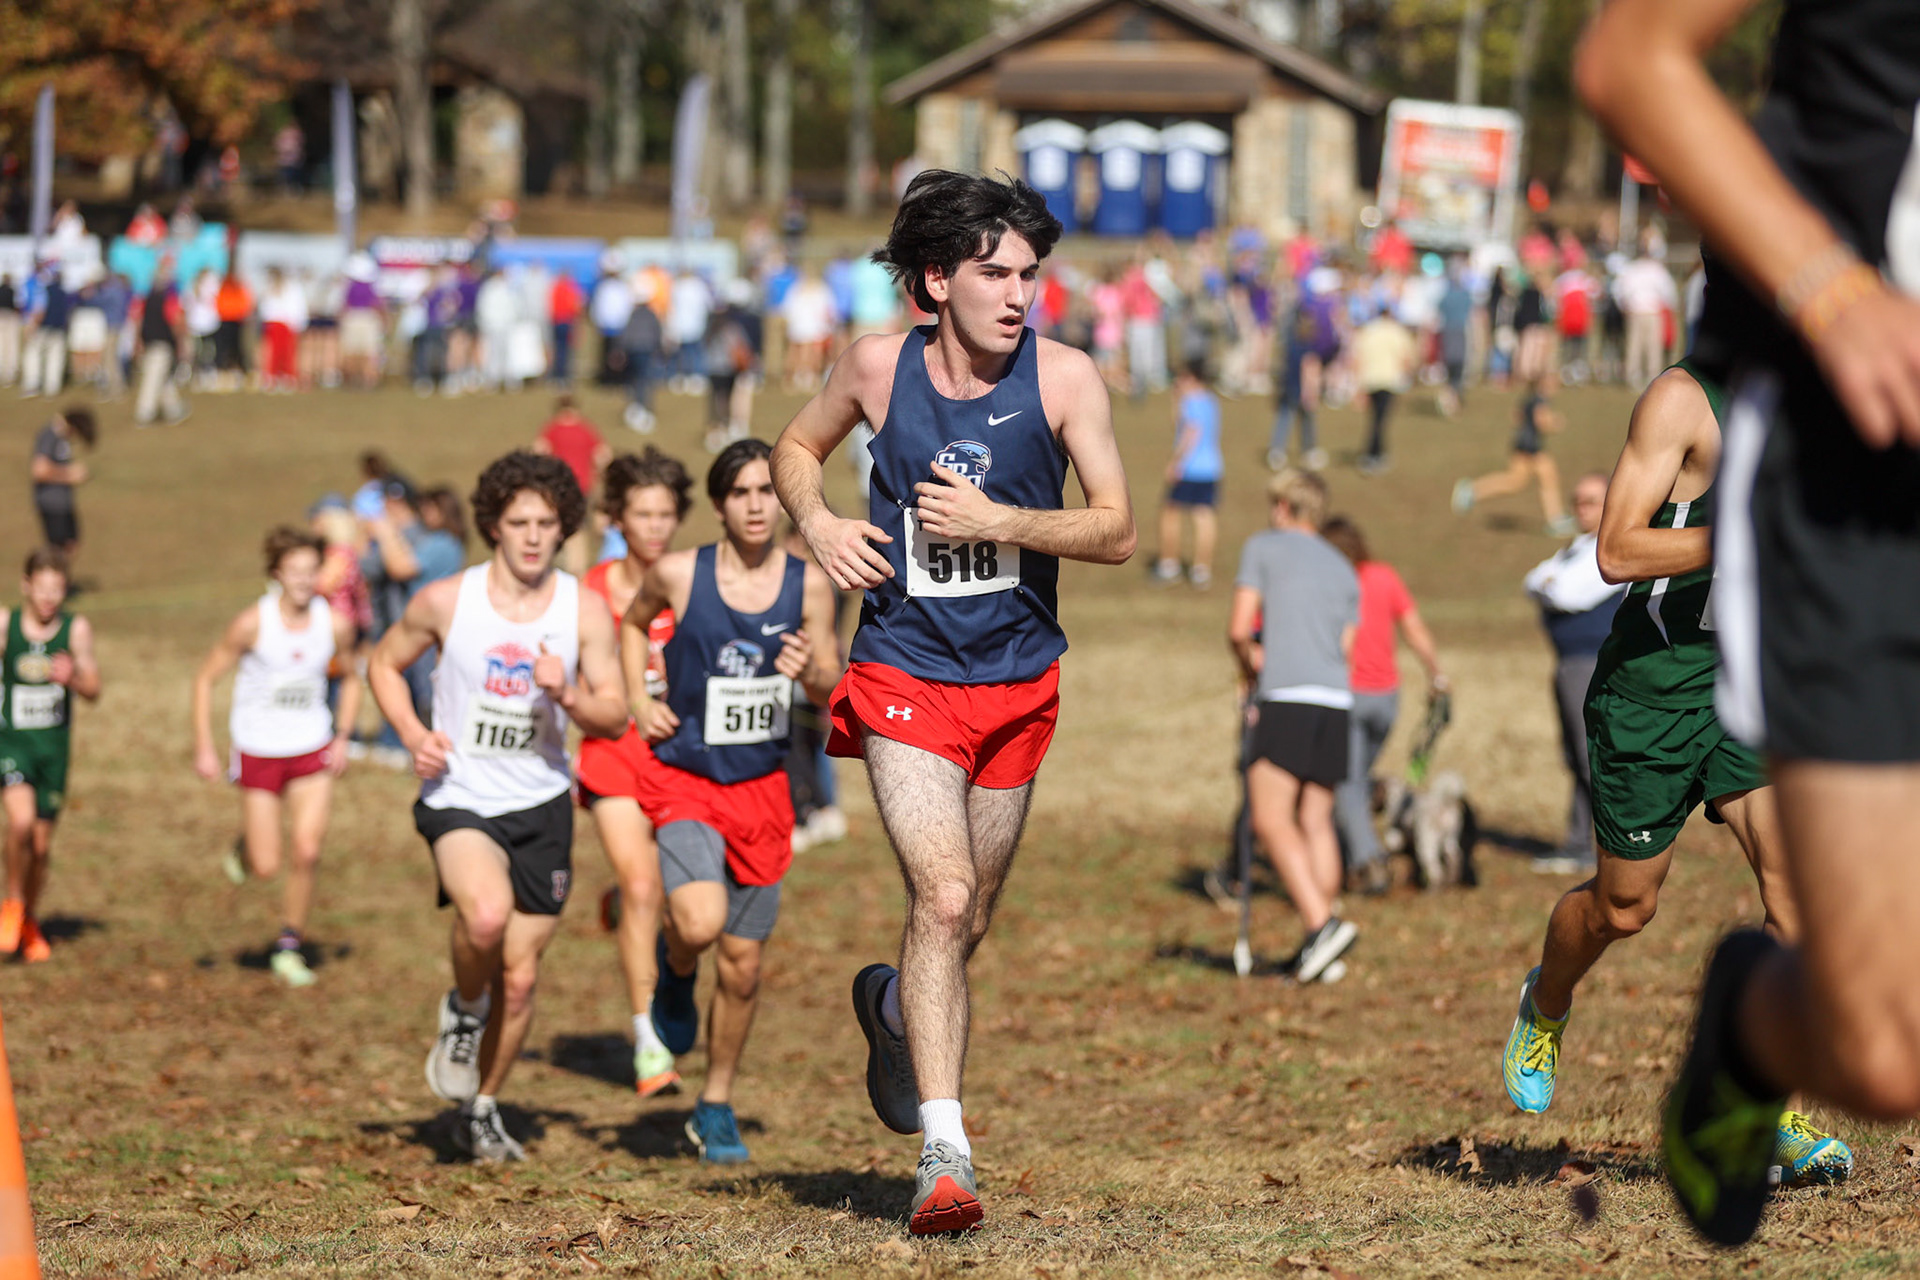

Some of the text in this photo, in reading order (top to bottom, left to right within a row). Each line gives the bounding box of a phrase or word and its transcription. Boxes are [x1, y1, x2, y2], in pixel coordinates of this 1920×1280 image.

[928, 541, 998, 583] 518
[726, 703, 773, 732] 519
[475, 722, 536, 749] 1162
